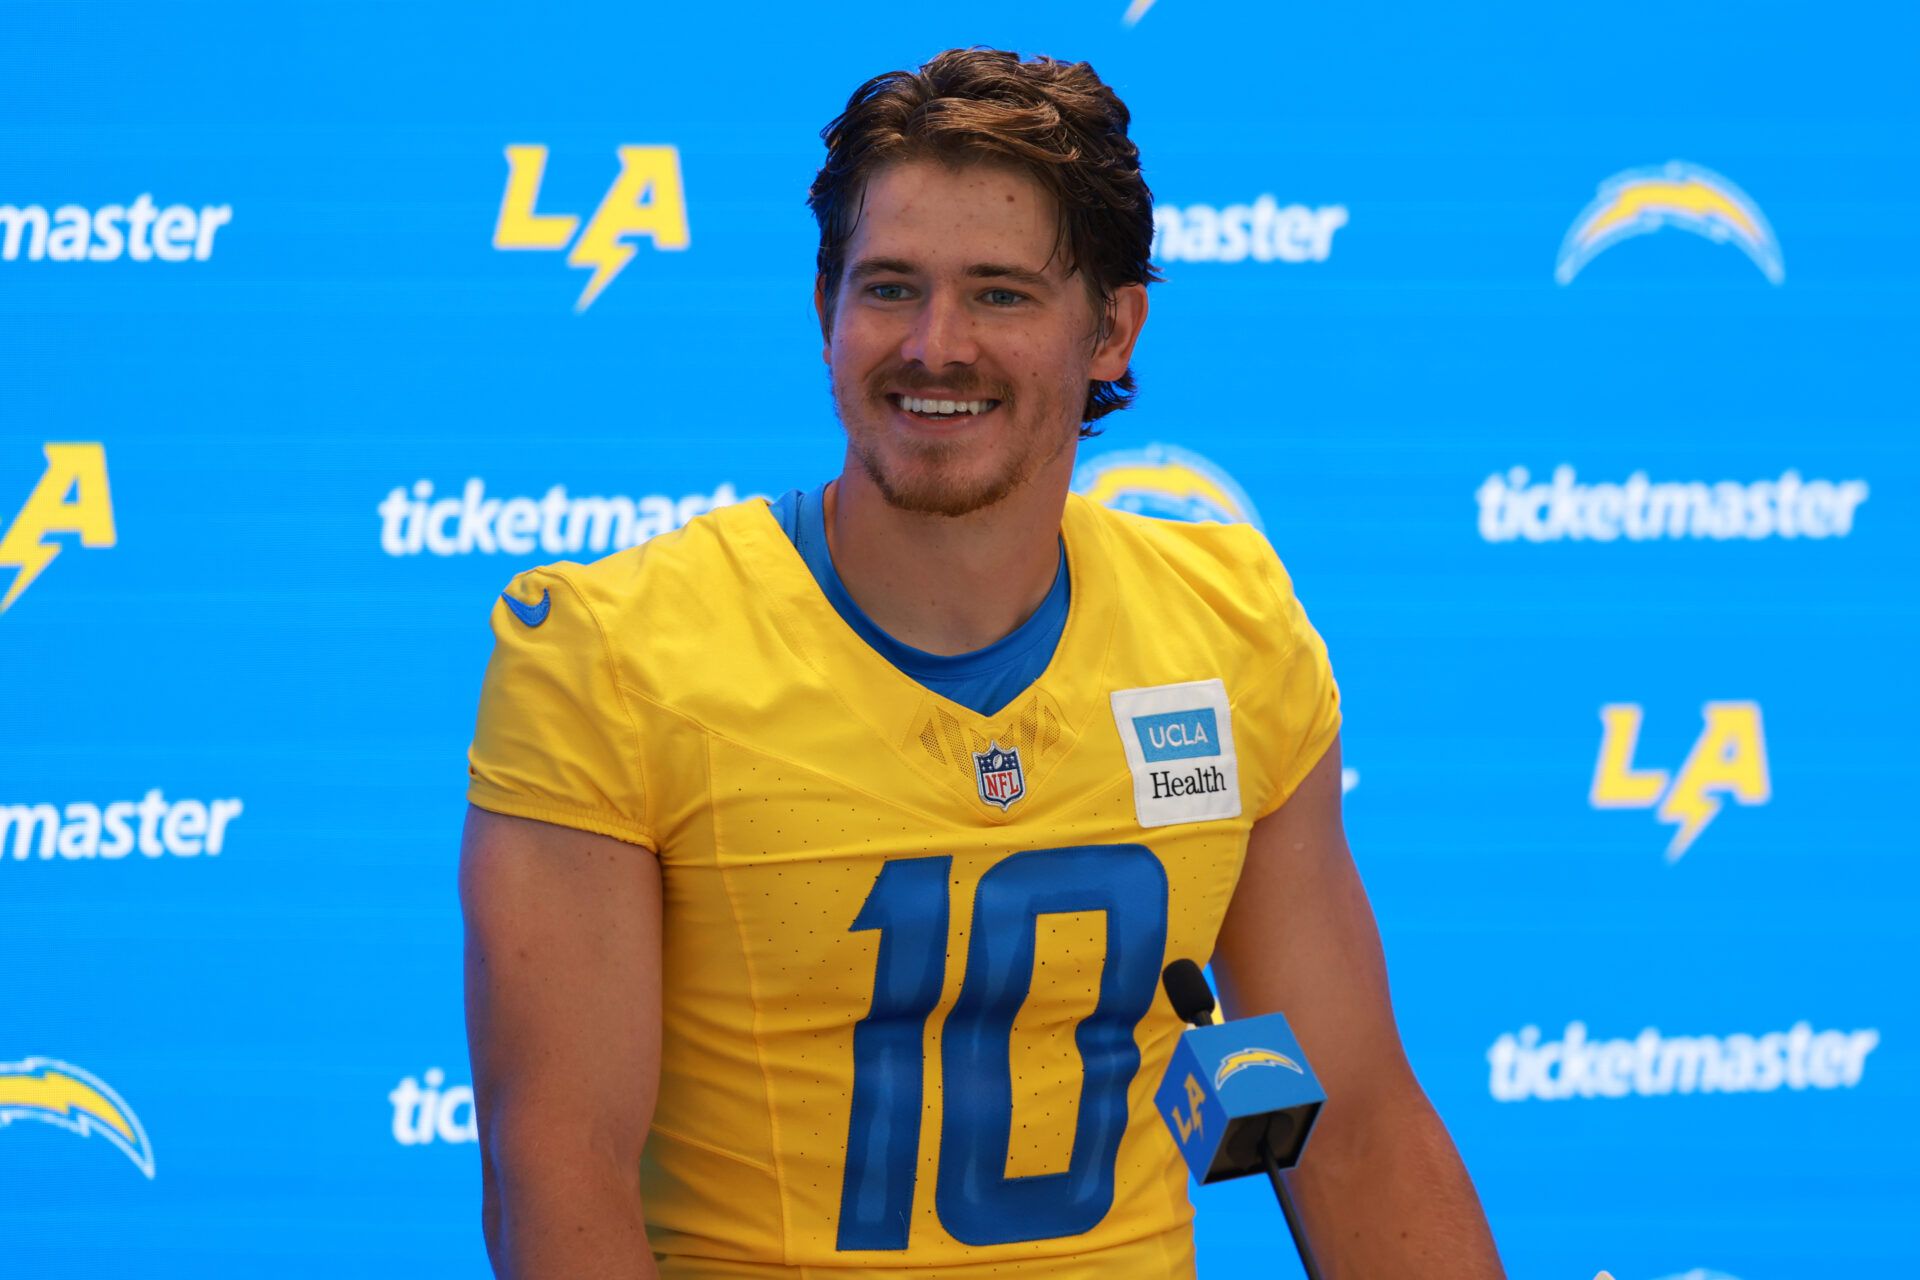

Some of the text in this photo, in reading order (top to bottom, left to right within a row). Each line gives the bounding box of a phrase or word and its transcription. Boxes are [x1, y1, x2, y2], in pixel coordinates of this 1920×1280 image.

[493, 144, 690, 310] LA
[1477, 466, 1867, 541] ticketmaster
[1149, 722, 1208, 749] UCLA
[985, 771, 1019, 799] NFL
[1149, 766, 1227, 799] Health
[1590, 701, 1771, 859] LA
[836, 843, 1168, 1251] 10
[1488, 1022, 1878, 1101] ticketmaster
[1171, 1072, 1206, 1146] LA
